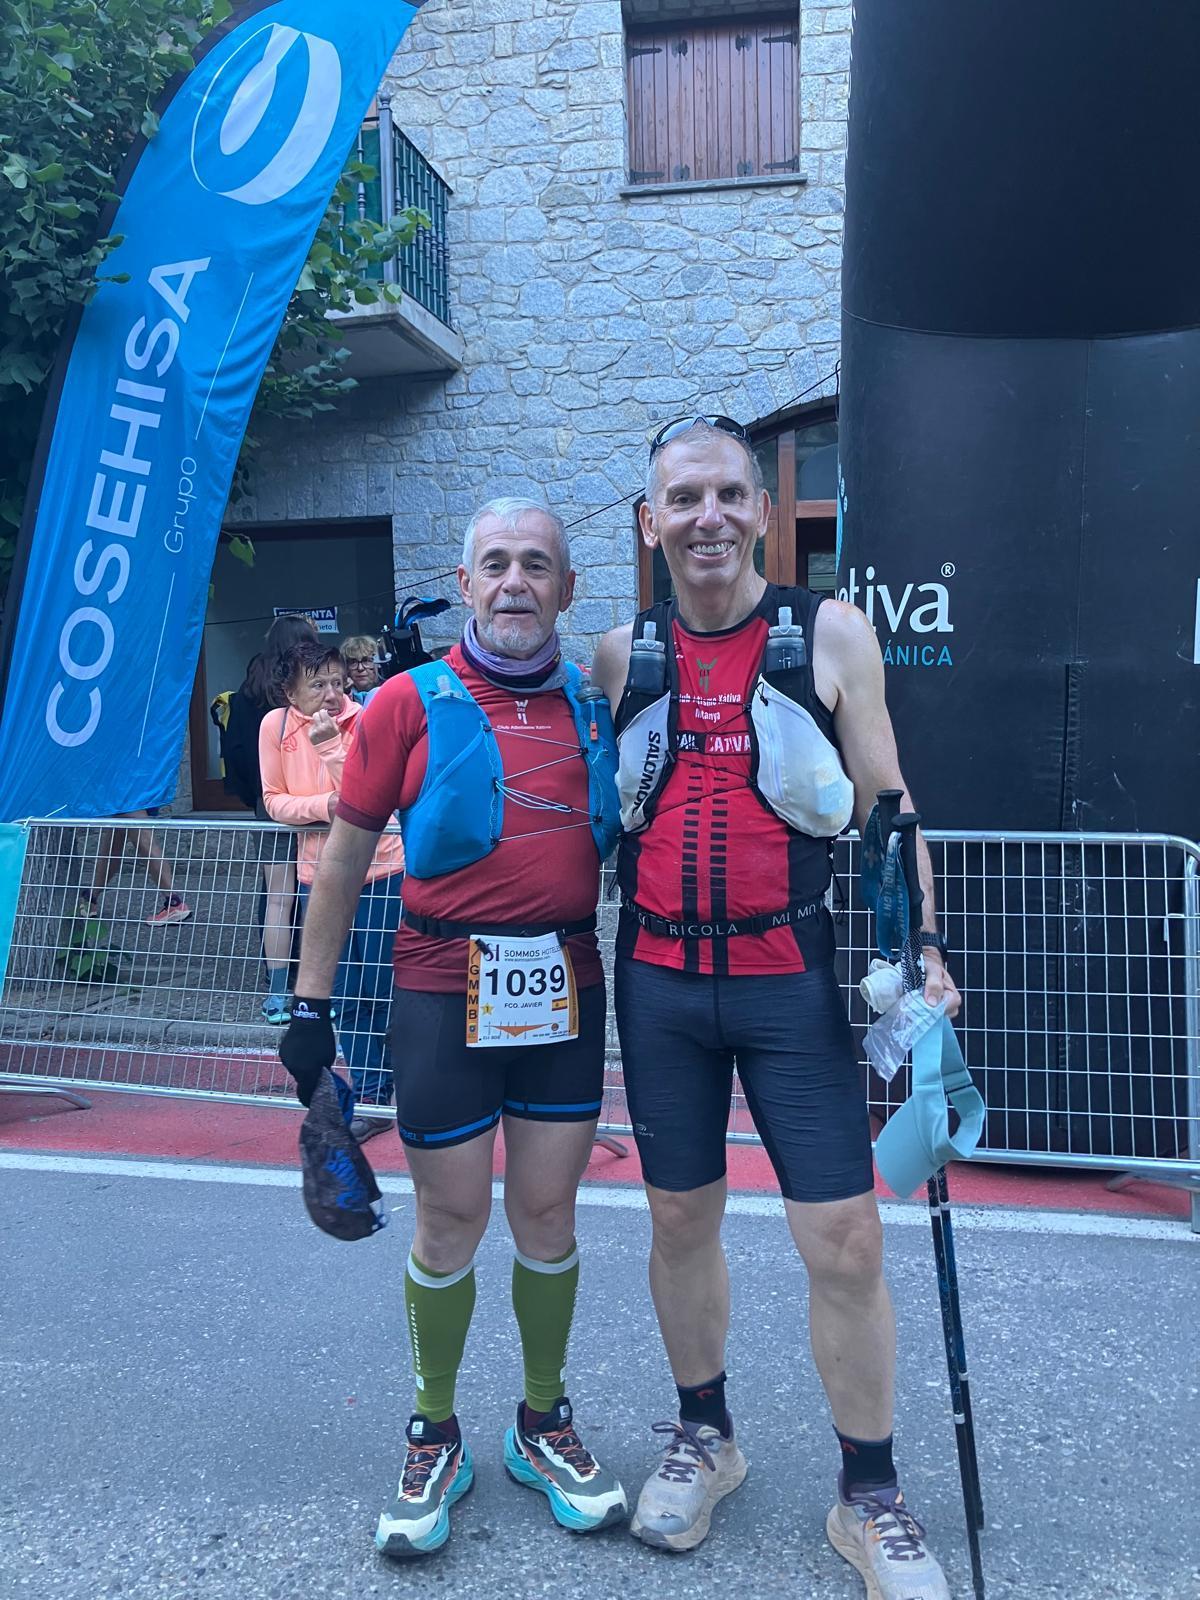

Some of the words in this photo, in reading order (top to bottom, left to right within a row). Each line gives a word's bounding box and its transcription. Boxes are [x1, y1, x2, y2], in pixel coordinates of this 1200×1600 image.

[45, 256, 211, 748] COSEHISA
[164, 456, 198, 554] Grupo
[836, 565, 954, 633] tiva
[881, 639, 953, 666] ÁNICA
[504, 949, 540, 958] SOMMOS
[485, 964, 565, 997] 1039
[520, 1001, 543, 1009] JAVIER
